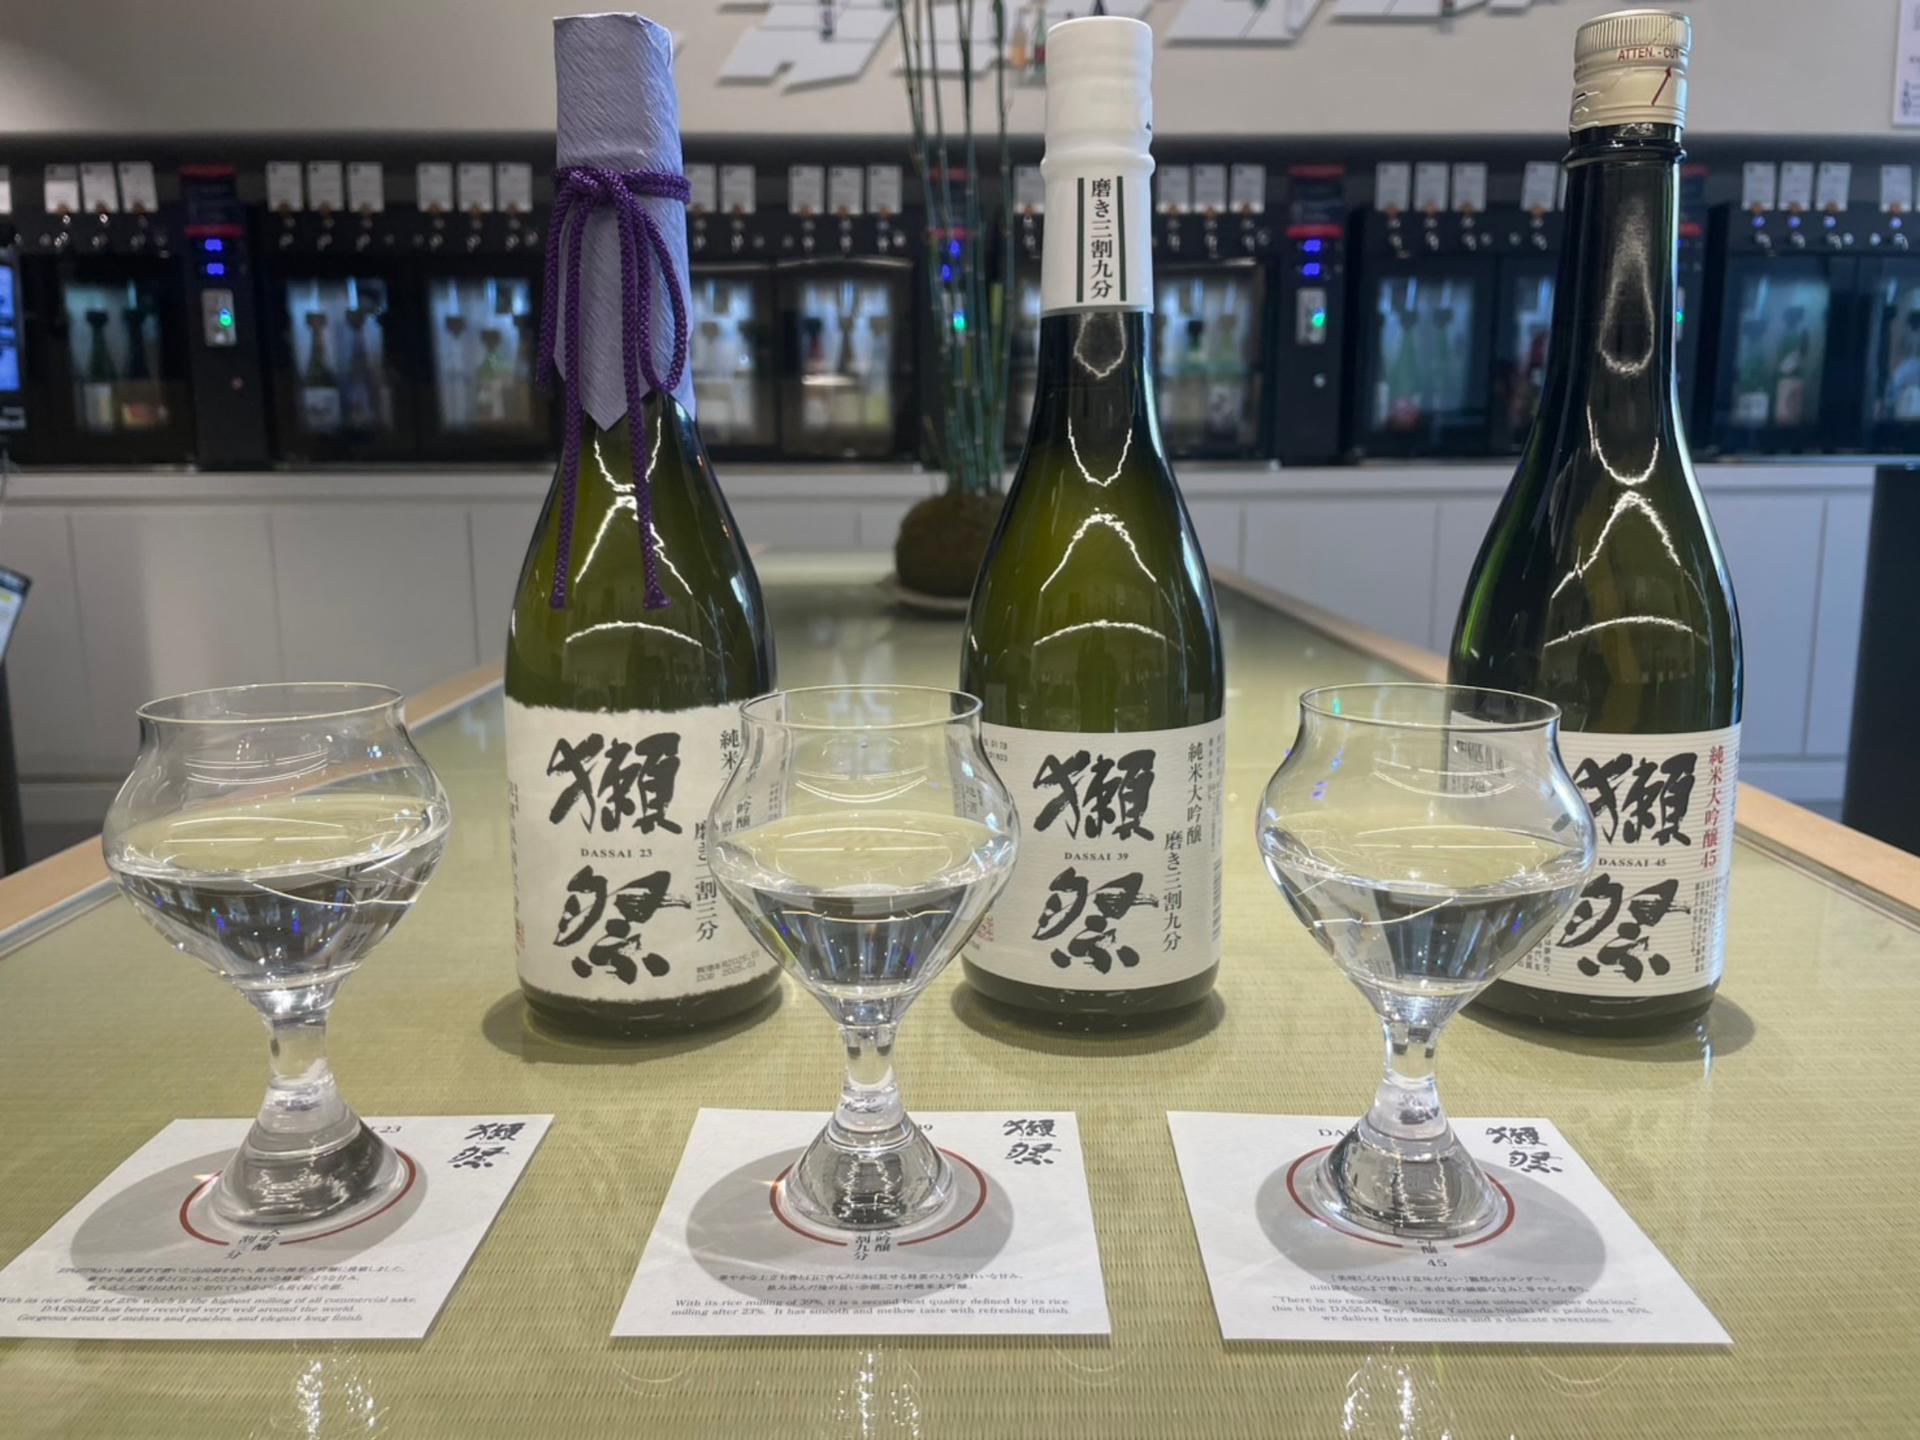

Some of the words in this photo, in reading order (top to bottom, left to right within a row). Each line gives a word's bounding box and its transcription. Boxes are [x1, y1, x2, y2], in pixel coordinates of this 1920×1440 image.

[1617, 47, 1655, 61] ATTEN.
[1663, 47, 1679, 59] CUT
[1090, 178, 1113, 299] 磨き三割九分
[1186, 742, 1203, 846] 純米大吟醸
[580, 848, 632, 858] DASSAI
[640, 848, 653, 858] 23
[1064, 852, 1111, 861] DASSAI
[1116, 852, 1129, 861] 39
[1599, 857, 1649, 867] DASSAI
[1654, 857, 1667, 867] 45
[1163, 830, 1184, 952] 磨き三割九分
[929, 1298, 966, 1307] quality
[671, 1308, 708, 1316] milling
[978, 1306, 1035, 1316] refreshing
